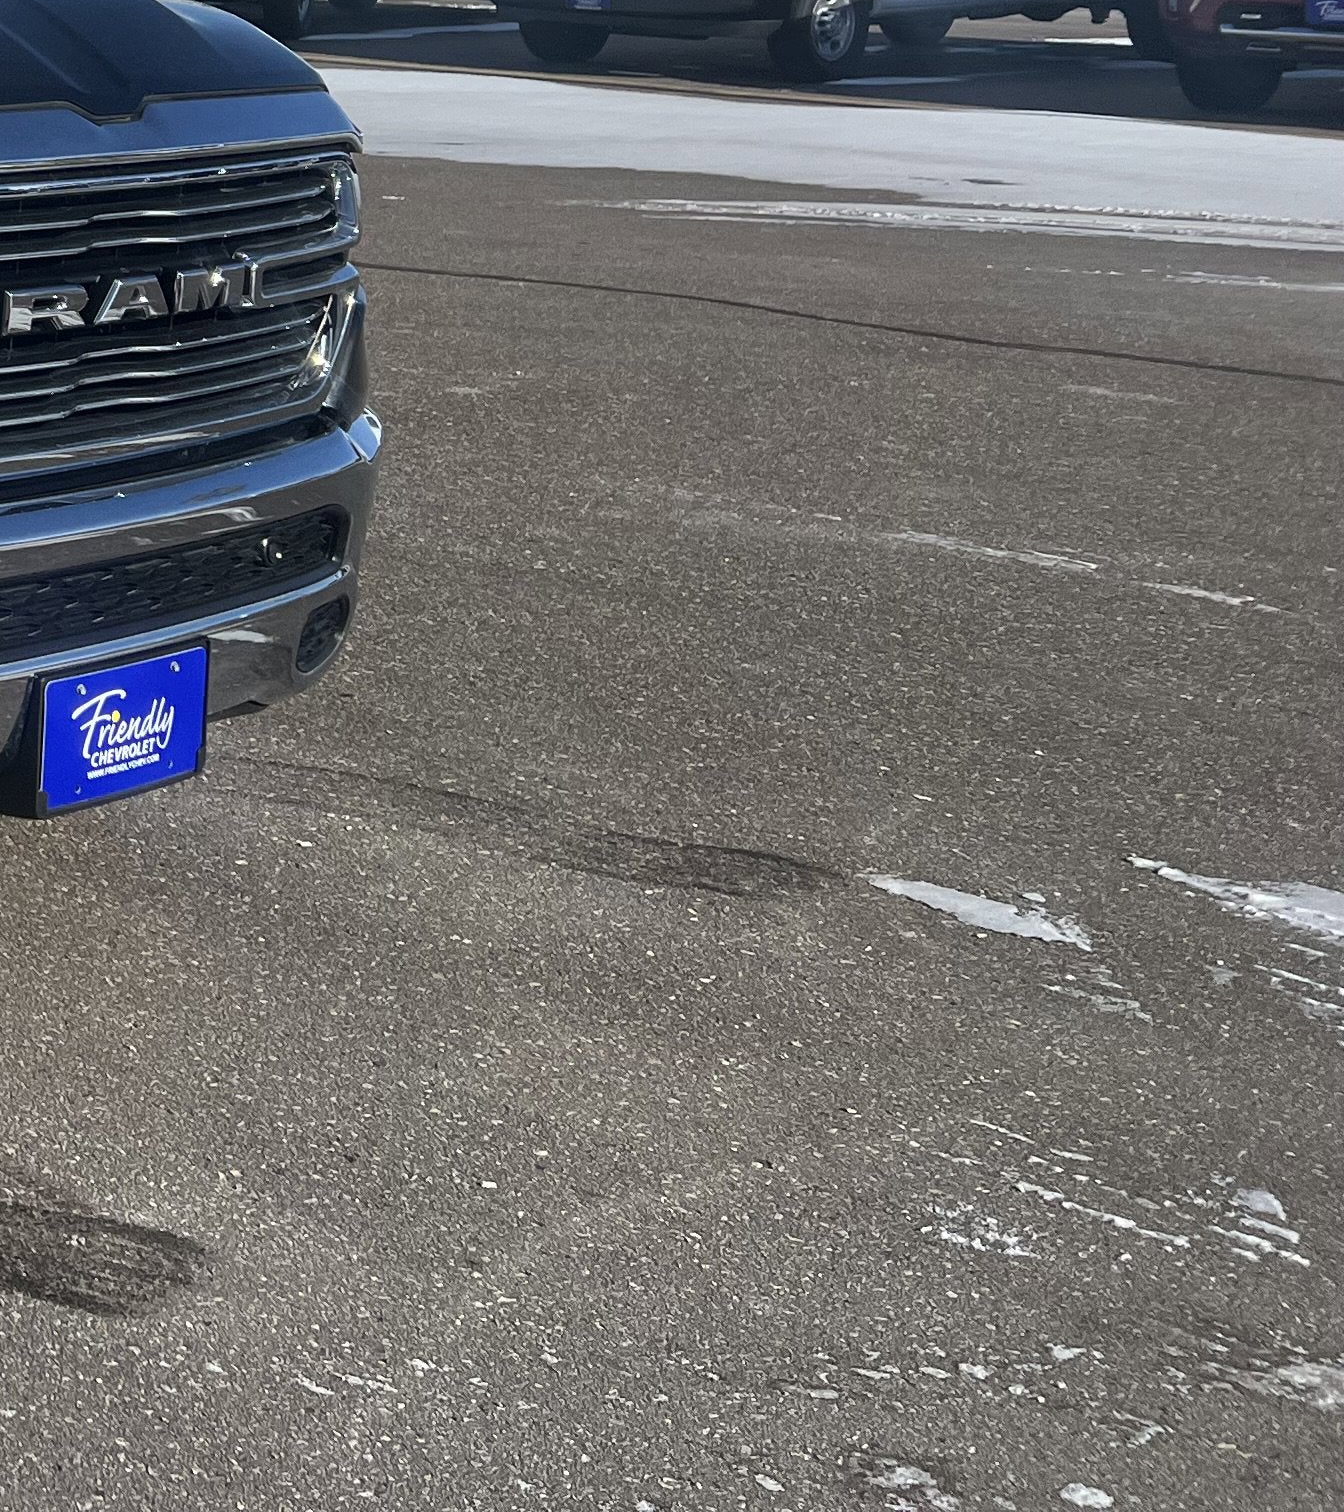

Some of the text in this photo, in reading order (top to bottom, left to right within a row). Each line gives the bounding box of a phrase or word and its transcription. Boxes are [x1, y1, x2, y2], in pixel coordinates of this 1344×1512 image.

[3, 261, 251, 337] RAM
[71, 688, 175, 760] Friendly
[90, 737, 156, 768] CHEVROLET
